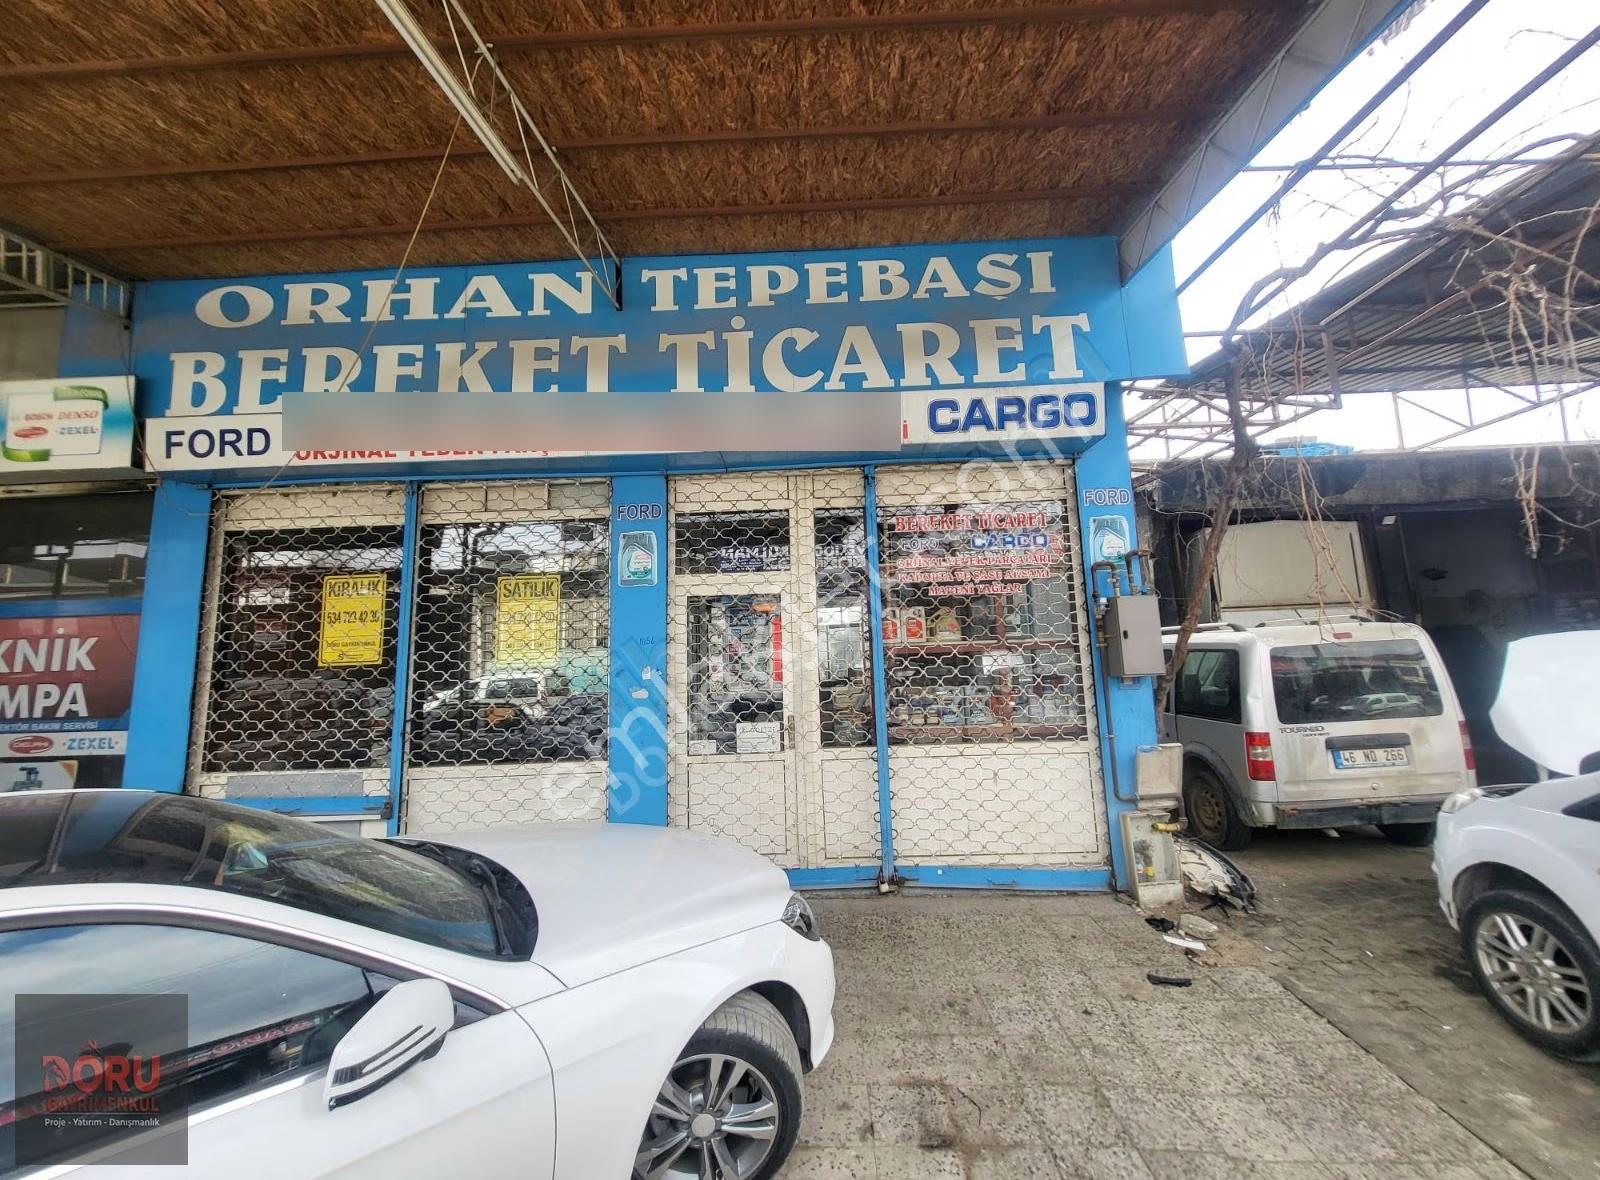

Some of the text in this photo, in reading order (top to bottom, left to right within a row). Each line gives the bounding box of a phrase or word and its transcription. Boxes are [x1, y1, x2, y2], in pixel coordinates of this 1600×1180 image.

[195, 251, 1056, 328] ORHAN TEPEBAŞI
[165, 312, 1091, 417] BEREKET TİCARET
[927, 391, 1097, 434] CARGO
[164, 427, 271, 459] FORD
[1083, 488, 1132, 506] FORD
[616, 503, 662, 520] FORD
[895, 513, 972, 532] BEREKET
[66, 737, 115, 750] ZEXEL
[1343, 752, 1356, 764] 46
[1385, 749, 1404, 762] 266
